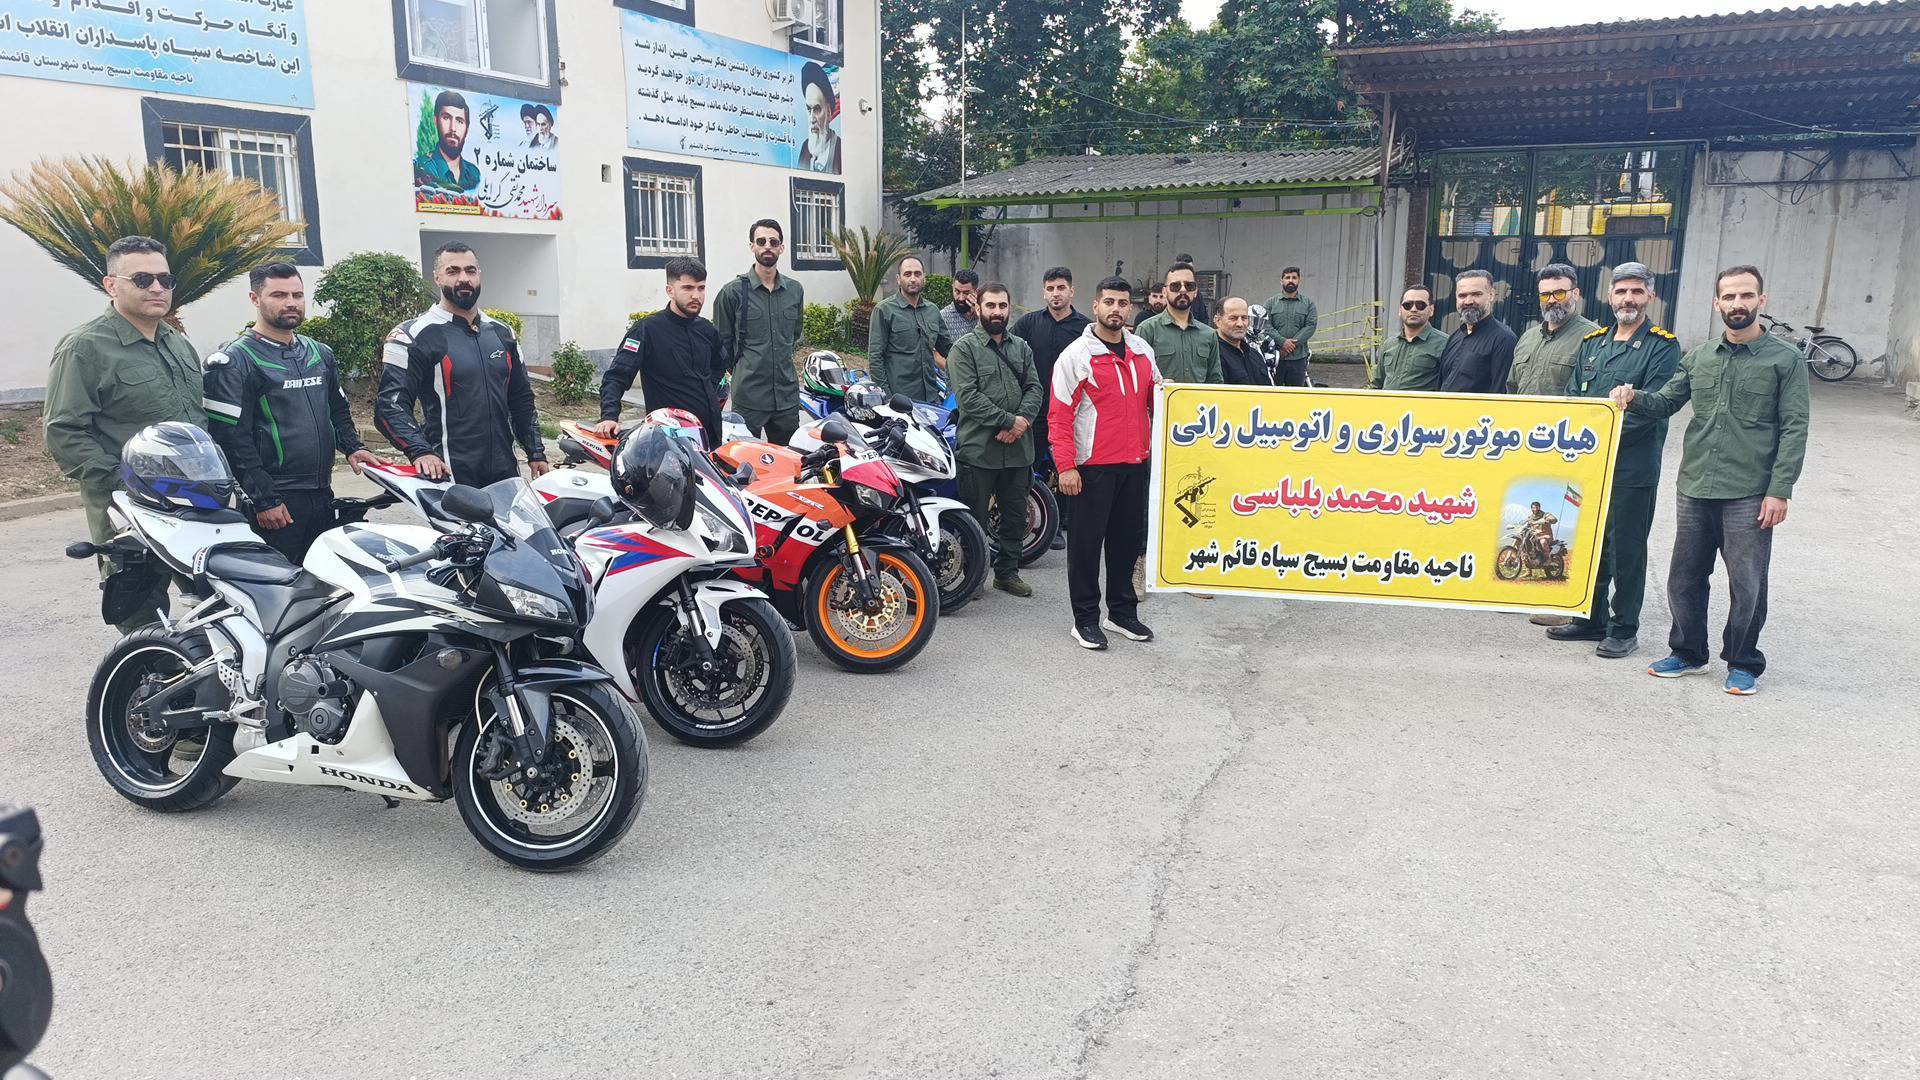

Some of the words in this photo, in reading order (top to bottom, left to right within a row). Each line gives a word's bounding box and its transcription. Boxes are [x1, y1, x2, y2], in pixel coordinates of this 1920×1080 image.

[145, 7, 153, 22] و
[158, 8, 234, 31] حرکت
[17, 20, 70, 38] انقلاب
[238, 19, 287, 39] آنگاه
[291, 31, 298, 45] و
[75, 27, 158, 56] پاسداران
[162, 39, 211, 62] سپاه
[634, 40, 651, 49] شد
[0, 50, 30, 63] قائمش
[34, 56, 79, 71] شهرستان
[215, 48, 276, 67] شاخصه
[280, 58, 300, 74] این
[82, 61, 104, 74] سپاه
[107, 66, 131, 76] بسیج
[134, 69, 168, 81] مقاومت
[637, 64, 659, 77] گردید
[661, 69, 683, 82] خواهد
[170, 73, 193, 83] ناحیه
[638, 88, 659, 99] گذشته
[689, 98, 706, 109] بسیج
[666, 116, 688, 127] ادامه
[689, 120, 703, 131] خود
[705, 121, 716, 133] کار
[474, 147, 481, 165] ۲
[485, 151, 514, 172] شماره
[517, 154, 557, 173] ساختمان
[1172, 405, 1231, 445] رانی
[1237, 407, 1331, 448] اتومبیل
[1335, 423, 1351, 450] و
[1528, 419, 1597, 458] هیات
[1233, 478, 1321, 515] بلباسی
[1326, 487, 1402, 511] محمد
[1407, 486, 1476, 521] شهید
[746, 498, 824, 542] EPOL
[1184, 541, 1219, 570] شهر
[1223, 539, 1257, 572] قائم
[1261, 544, 1300, 576] سپاه
[1303, 553, 1348, 578] بسیج
[1351, 550, 1420, 581] مقاومت
[1424, 554, 1473, 583] ناحیه
[318, 765, 418, 794] HONDA
